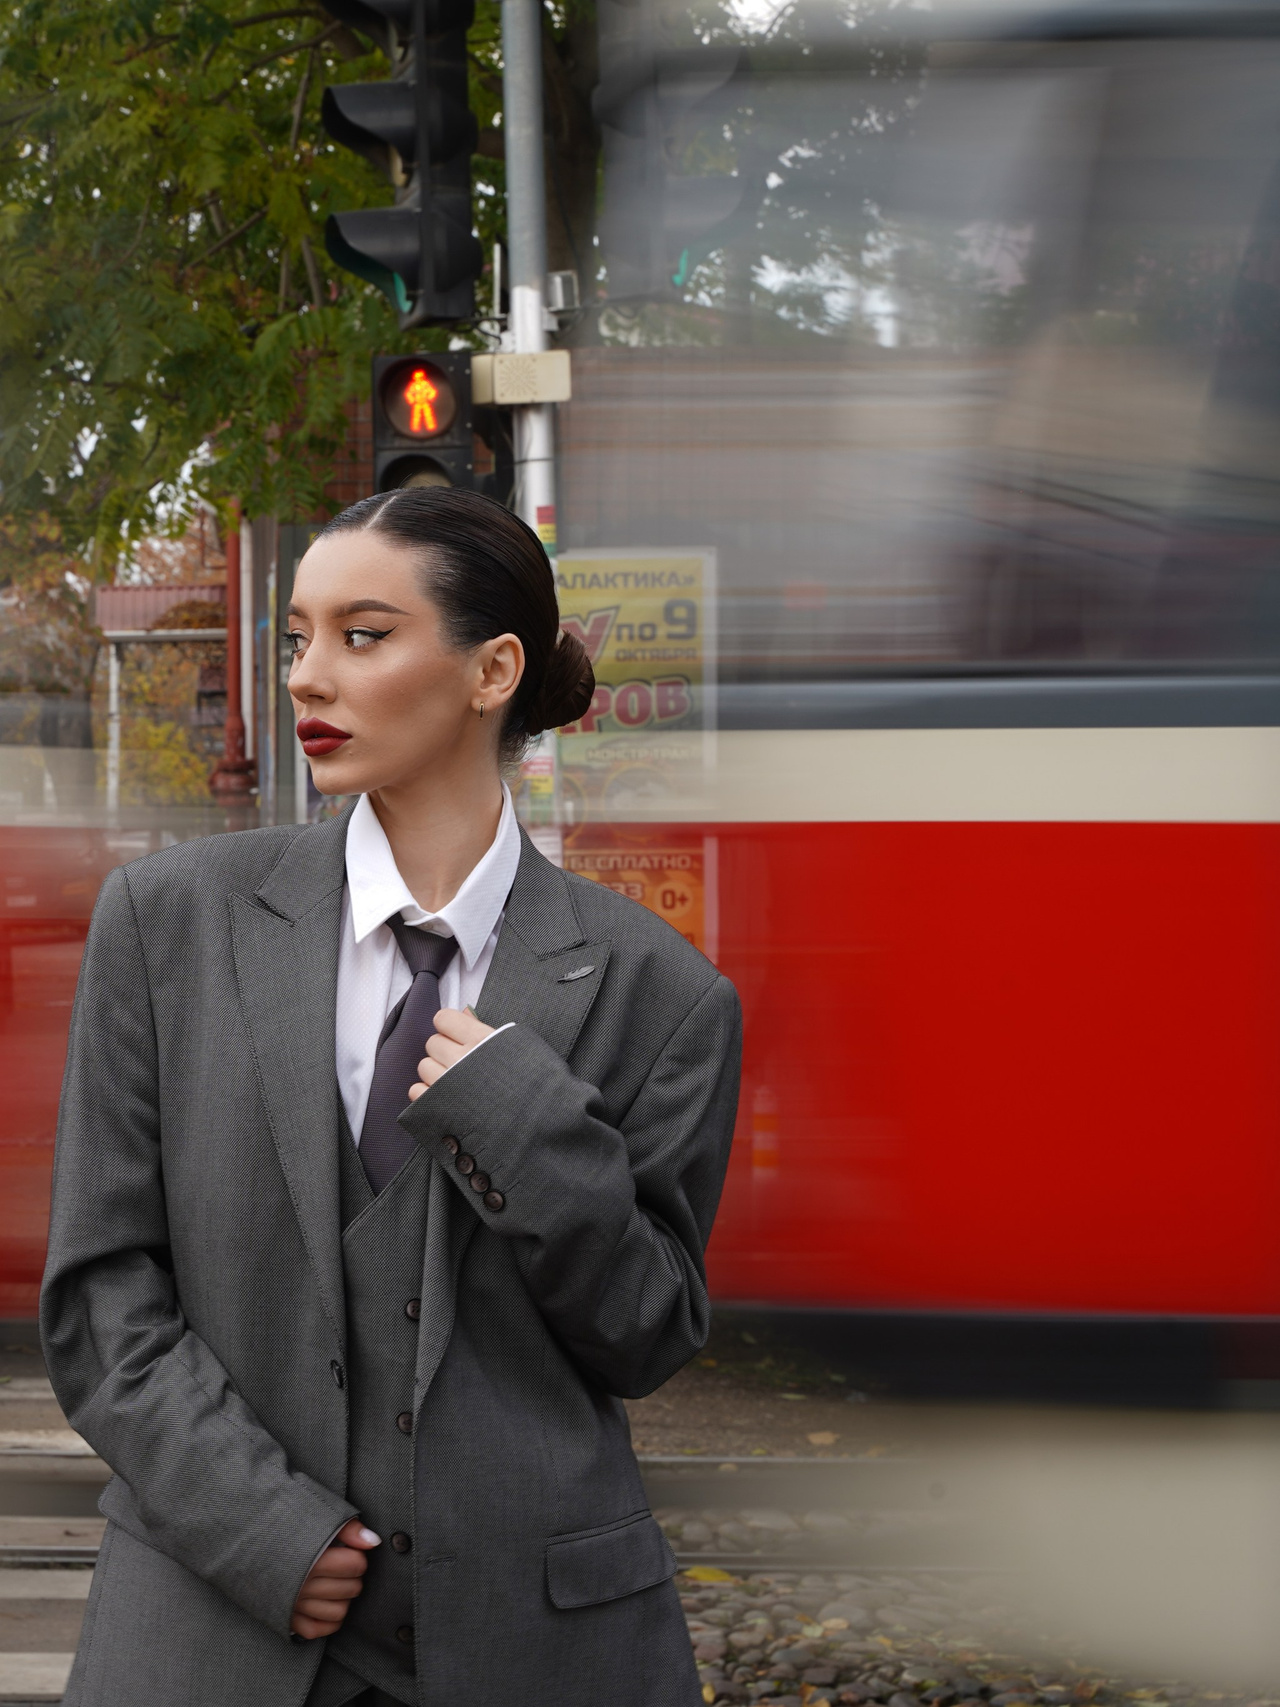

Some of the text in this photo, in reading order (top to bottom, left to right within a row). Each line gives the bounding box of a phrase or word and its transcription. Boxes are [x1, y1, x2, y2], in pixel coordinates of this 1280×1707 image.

[664, 599, 697, 640] 9
[615, 647, 697, 662] ОКТЯБРЯ
[558, 676, 692, 736] РОВ
[569, 855, 692, 872] БЕСПЛАТНО
[661, 889, 689, 911] 0+
